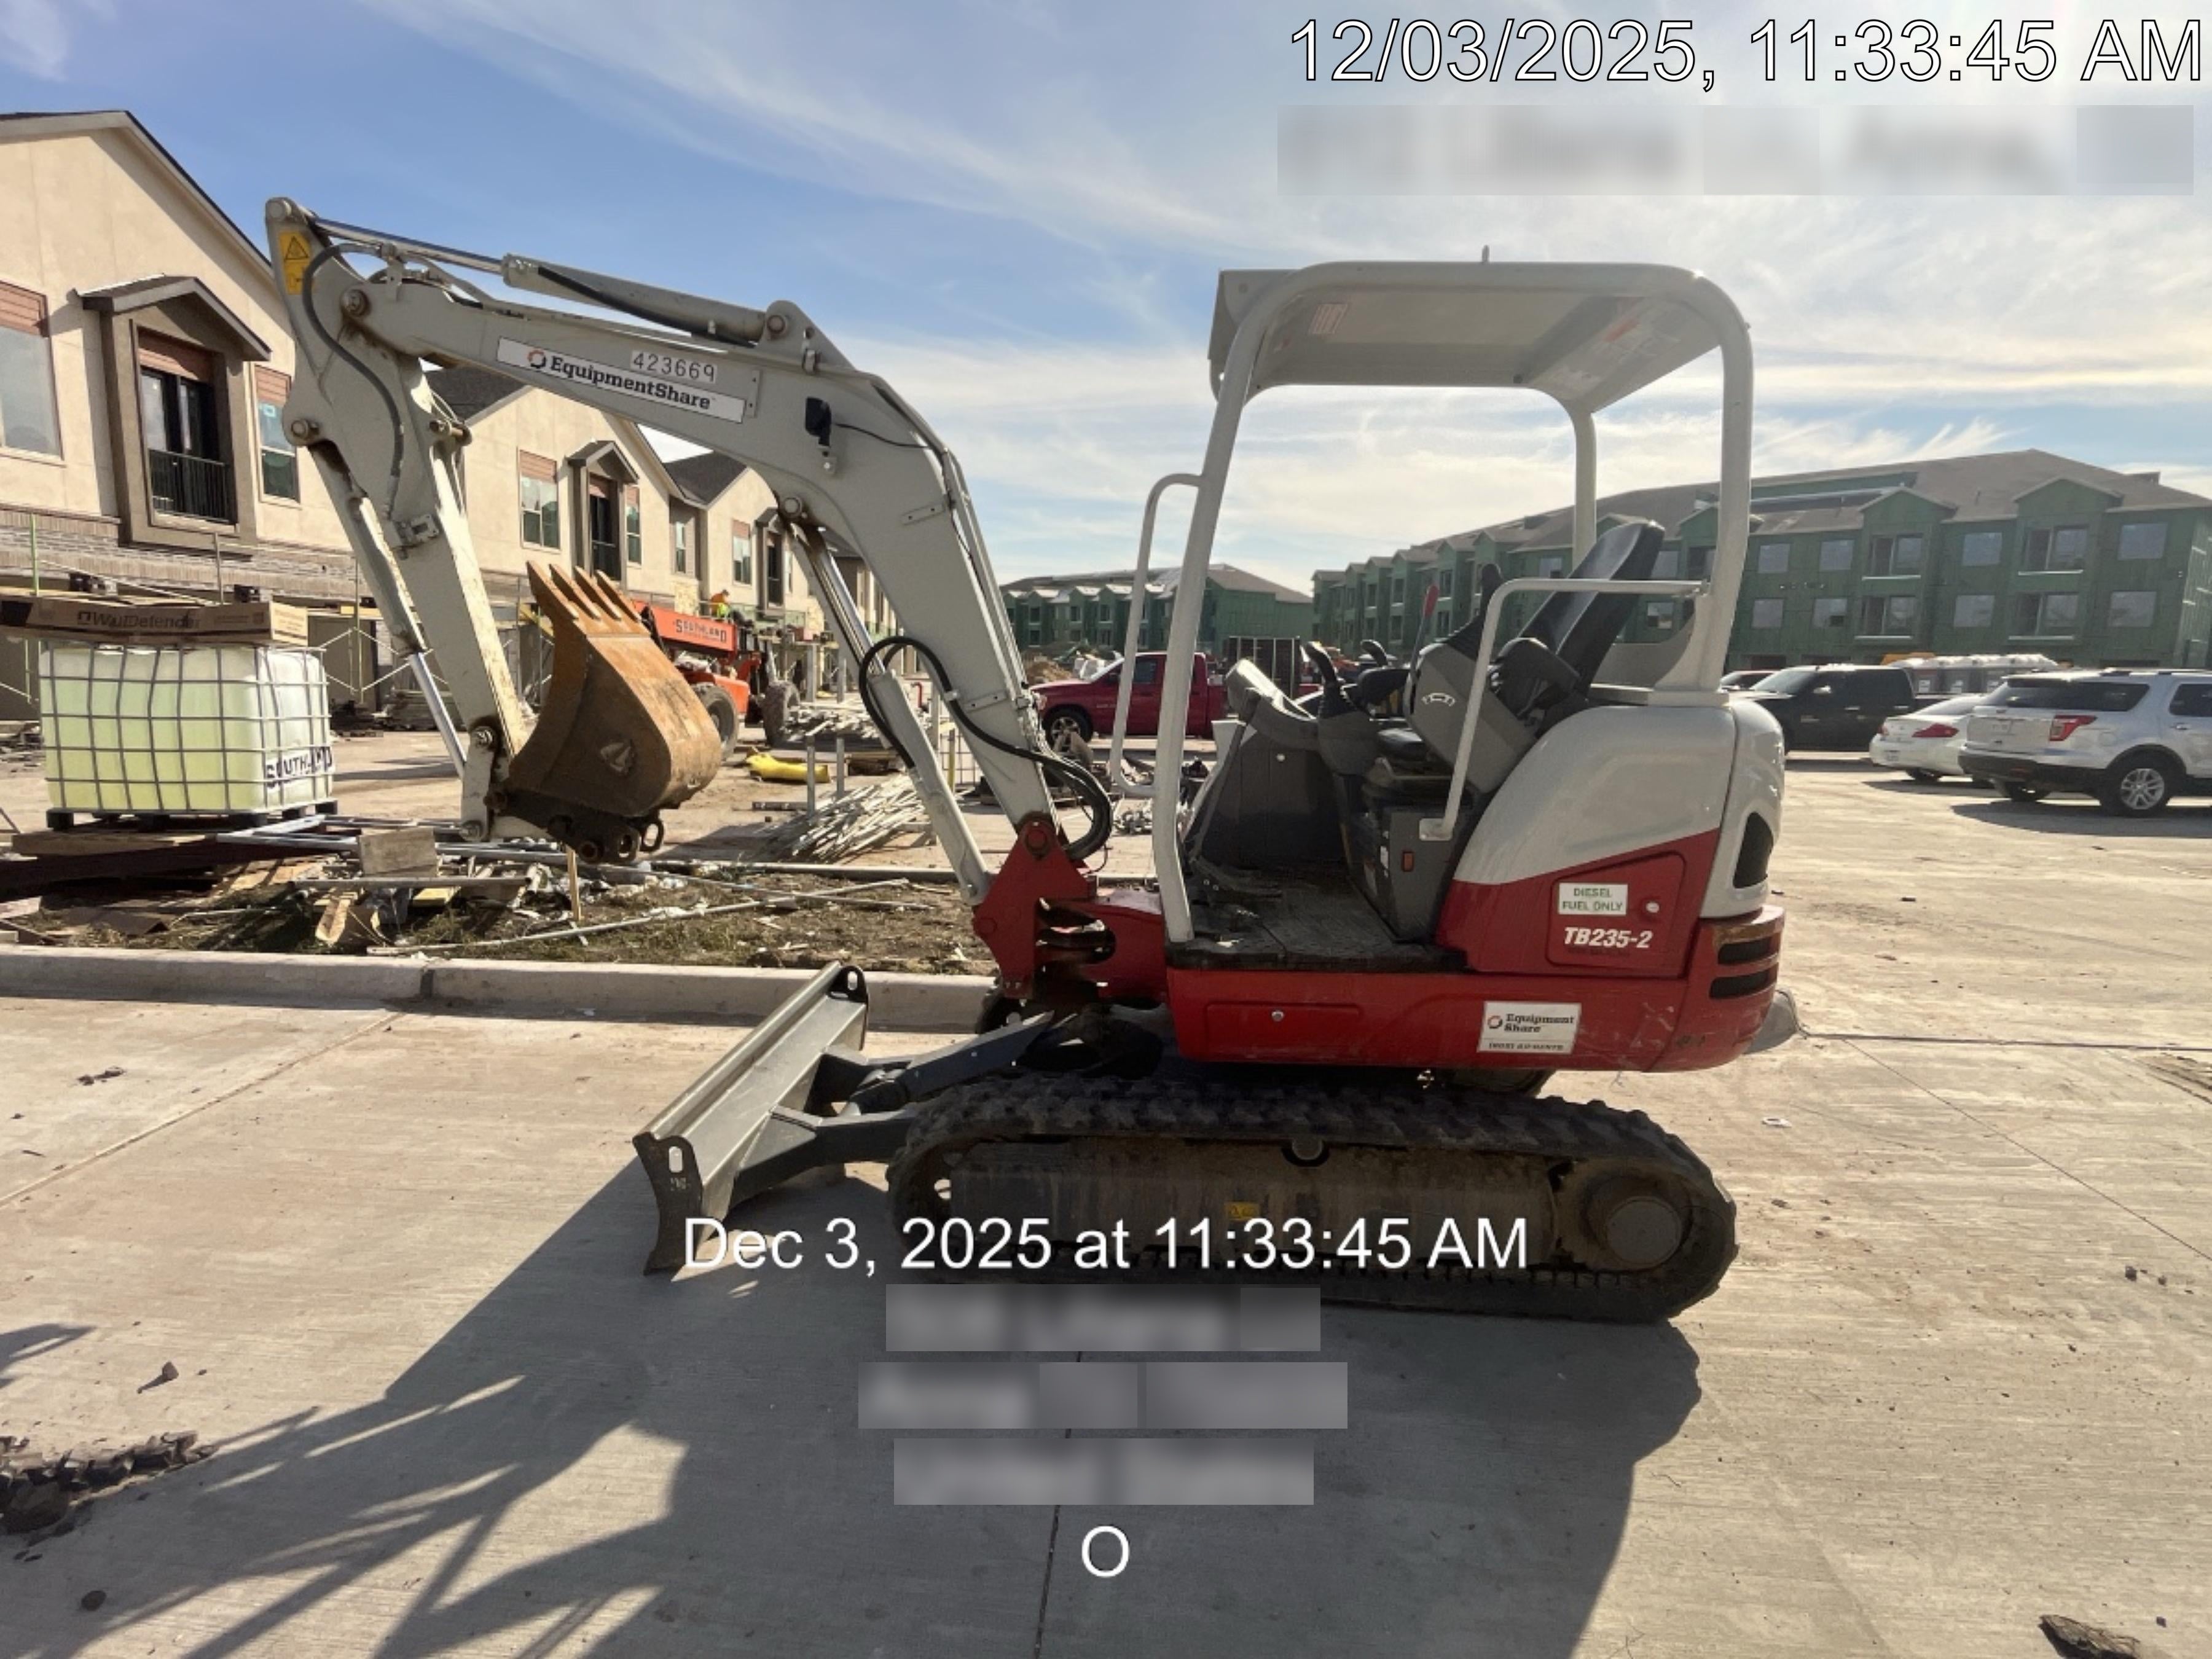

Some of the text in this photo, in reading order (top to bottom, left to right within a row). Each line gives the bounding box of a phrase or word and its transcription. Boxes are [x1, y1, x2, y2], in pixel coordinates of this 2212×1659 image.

[633, 351, 715, 382] 423669
[551, 355, 712, 410] EquipmentShare
[1573, 887, 1612, 897] DIESEL
[1562, 901, 1623, 911] FUEL ONLY
[1564, 927, 1653, 949] TB235-2
[1506, 1013, 1575, 1025] Equipment
[1504, 1022, 1542, 1033] Share
